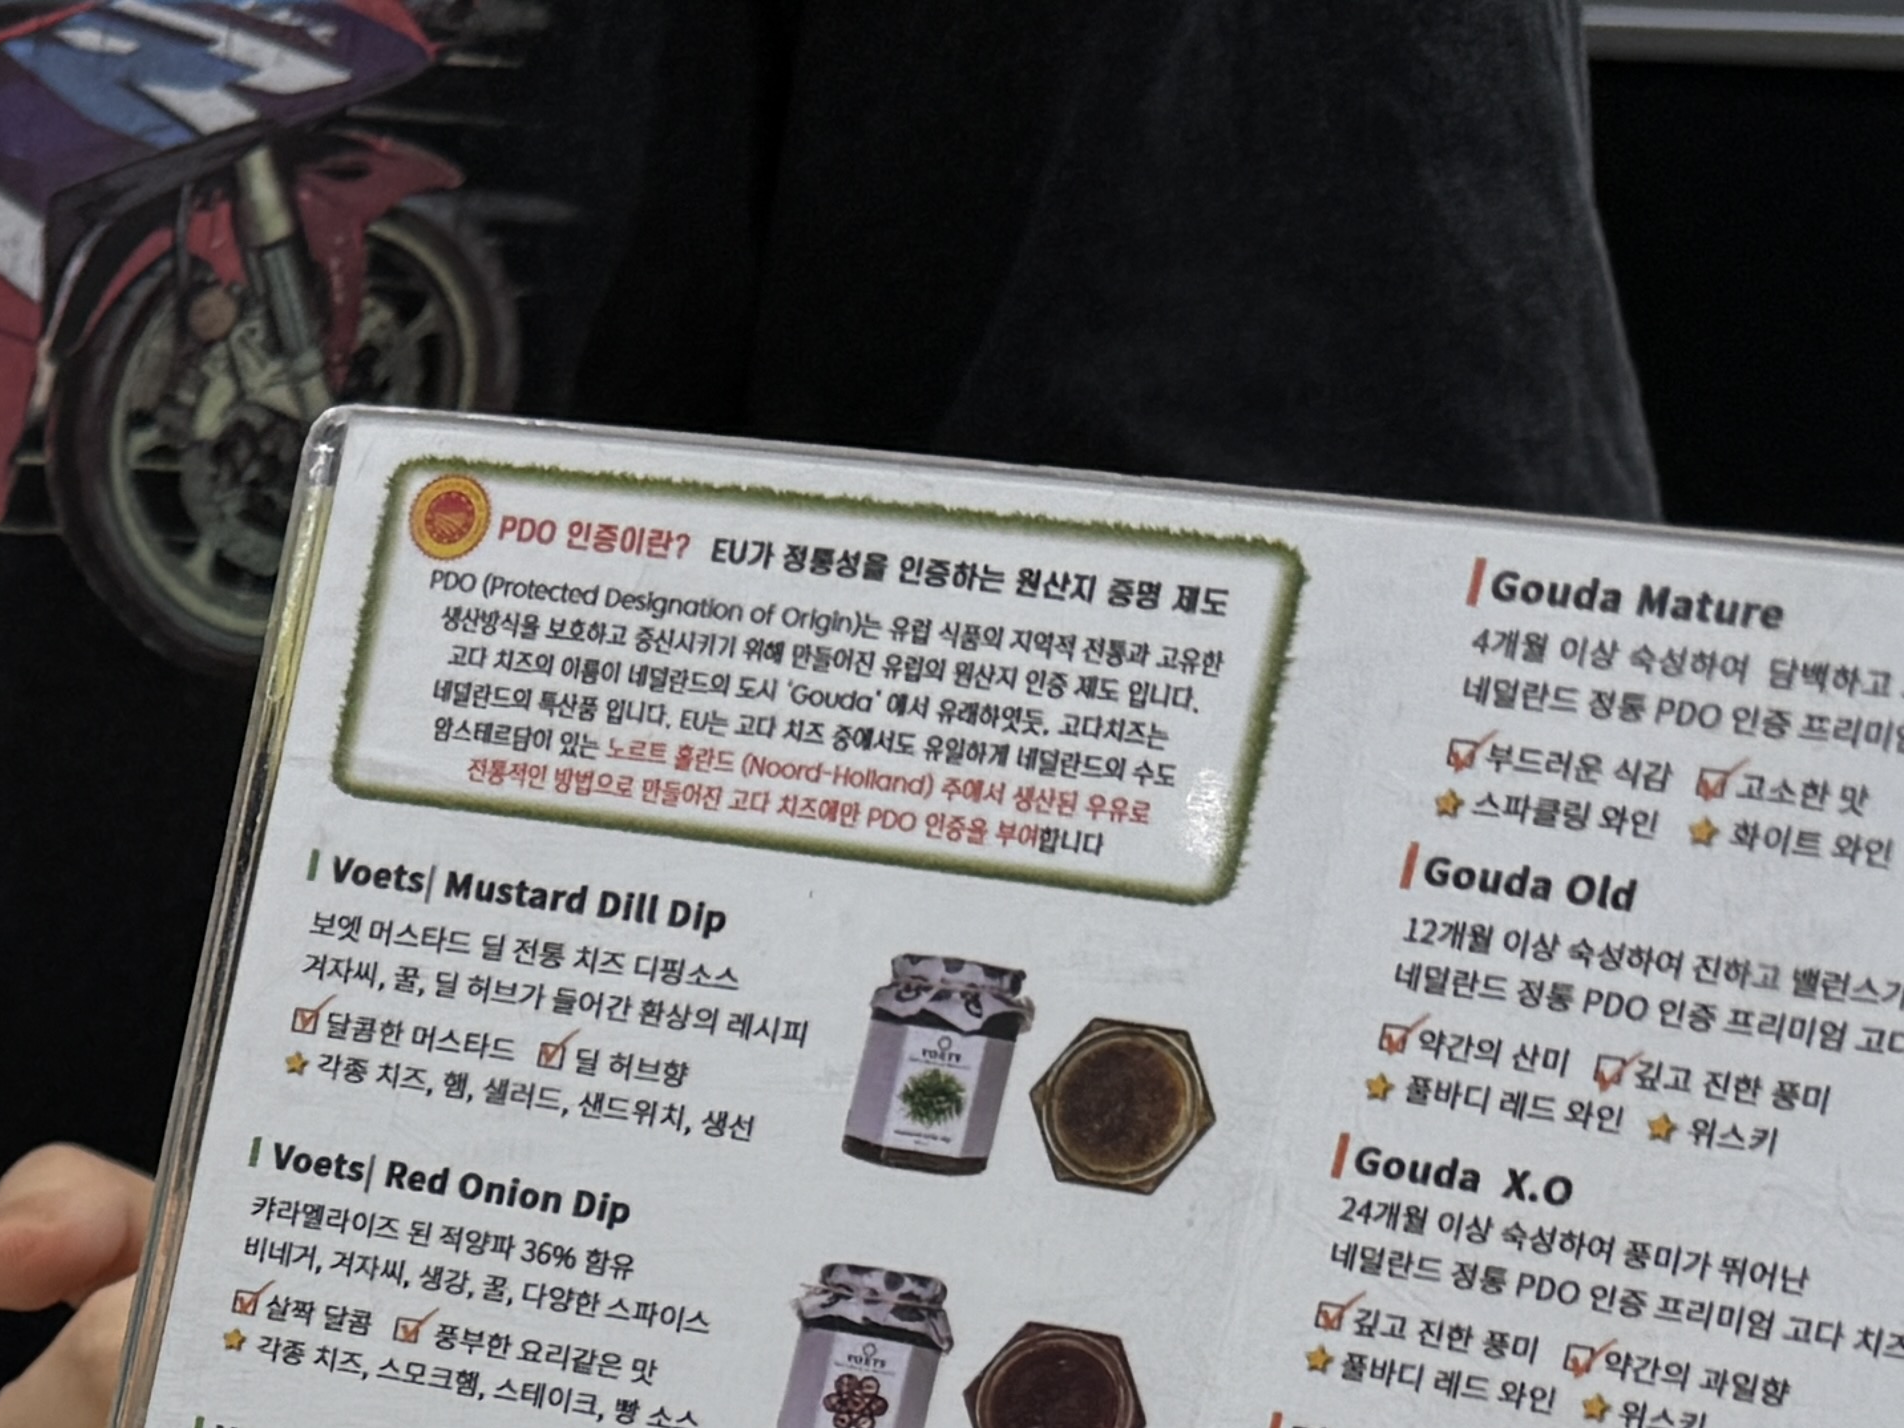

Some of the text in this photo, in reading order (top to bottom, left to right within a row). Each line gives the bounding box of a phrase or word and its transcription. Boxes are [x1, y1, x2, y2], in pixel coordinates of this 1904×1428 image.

[496, 514, 1230, 617] PDO 인증이란? EU가 정통성을 인증하는 원산지 증명 제도
[428, 567, 1225, 679] PDO (Protected Designation of Origin)는 유럽 식품의 지역적 전통과 고유한
[1490, 569, 1784, 630] Gouda Mature
[442, 869, 589, 916] Mustard
[595, 889, 660, 925] Dill
[665, 898, 727, 940] Dip
[1422, 855, 1638, 913] Gouda Old
[1353, 1145, 1574, 1207] Gouda X.O
